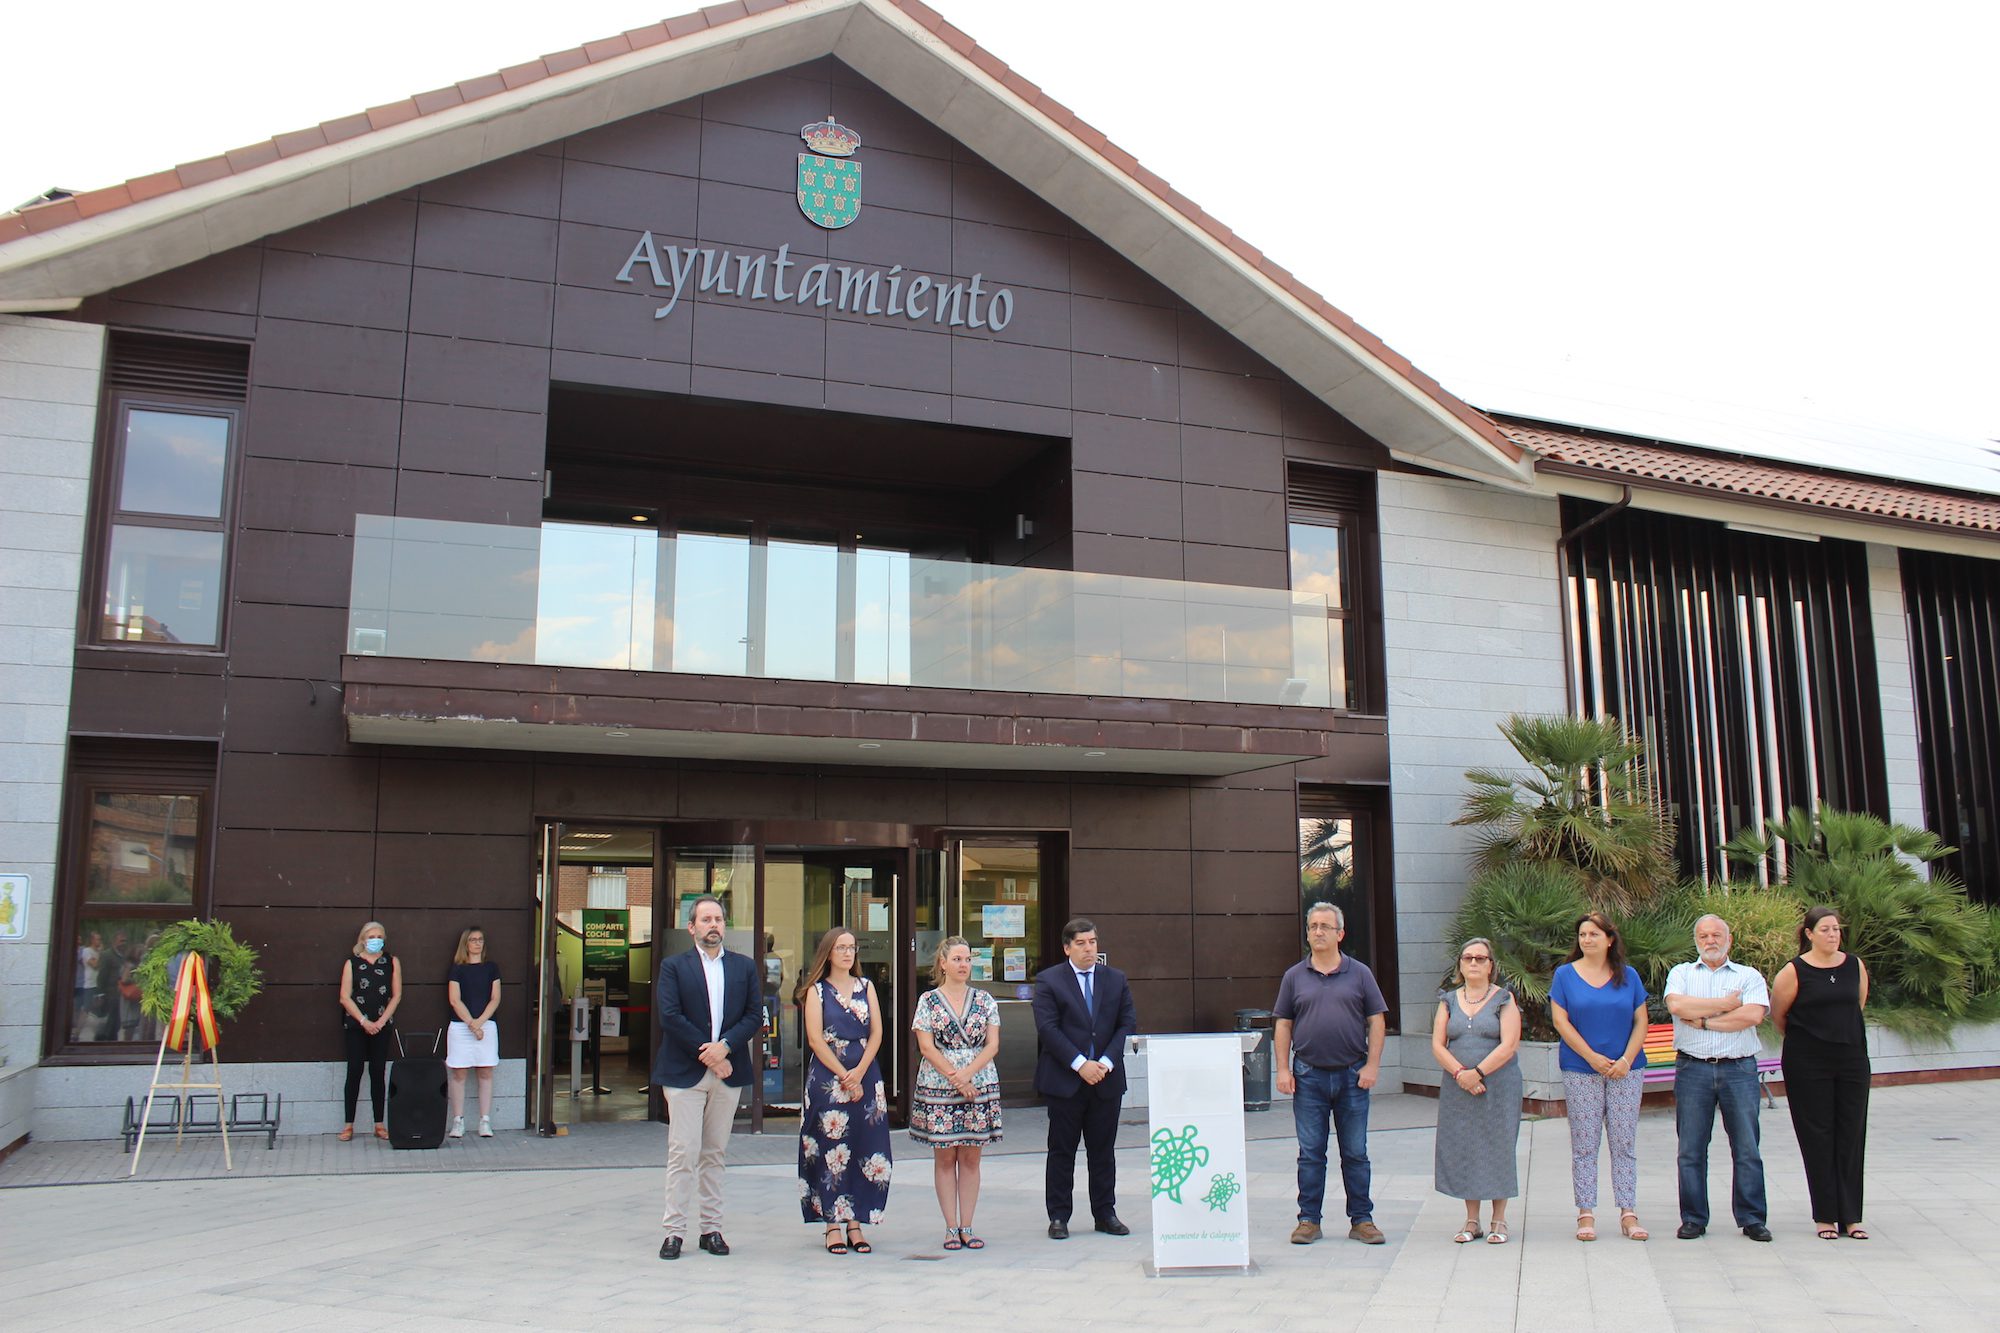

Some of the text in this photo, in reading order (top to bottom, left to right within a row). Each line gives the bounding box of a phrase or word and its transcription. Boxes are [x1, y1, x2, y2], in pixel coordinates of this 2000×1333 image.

[615, 230, 1015, 333] Ayuntamiento
[585, 923, 624, 931] COMPARTE
[1160, 1229, 1241, 1243] Ayuntamiento de Galapagar
